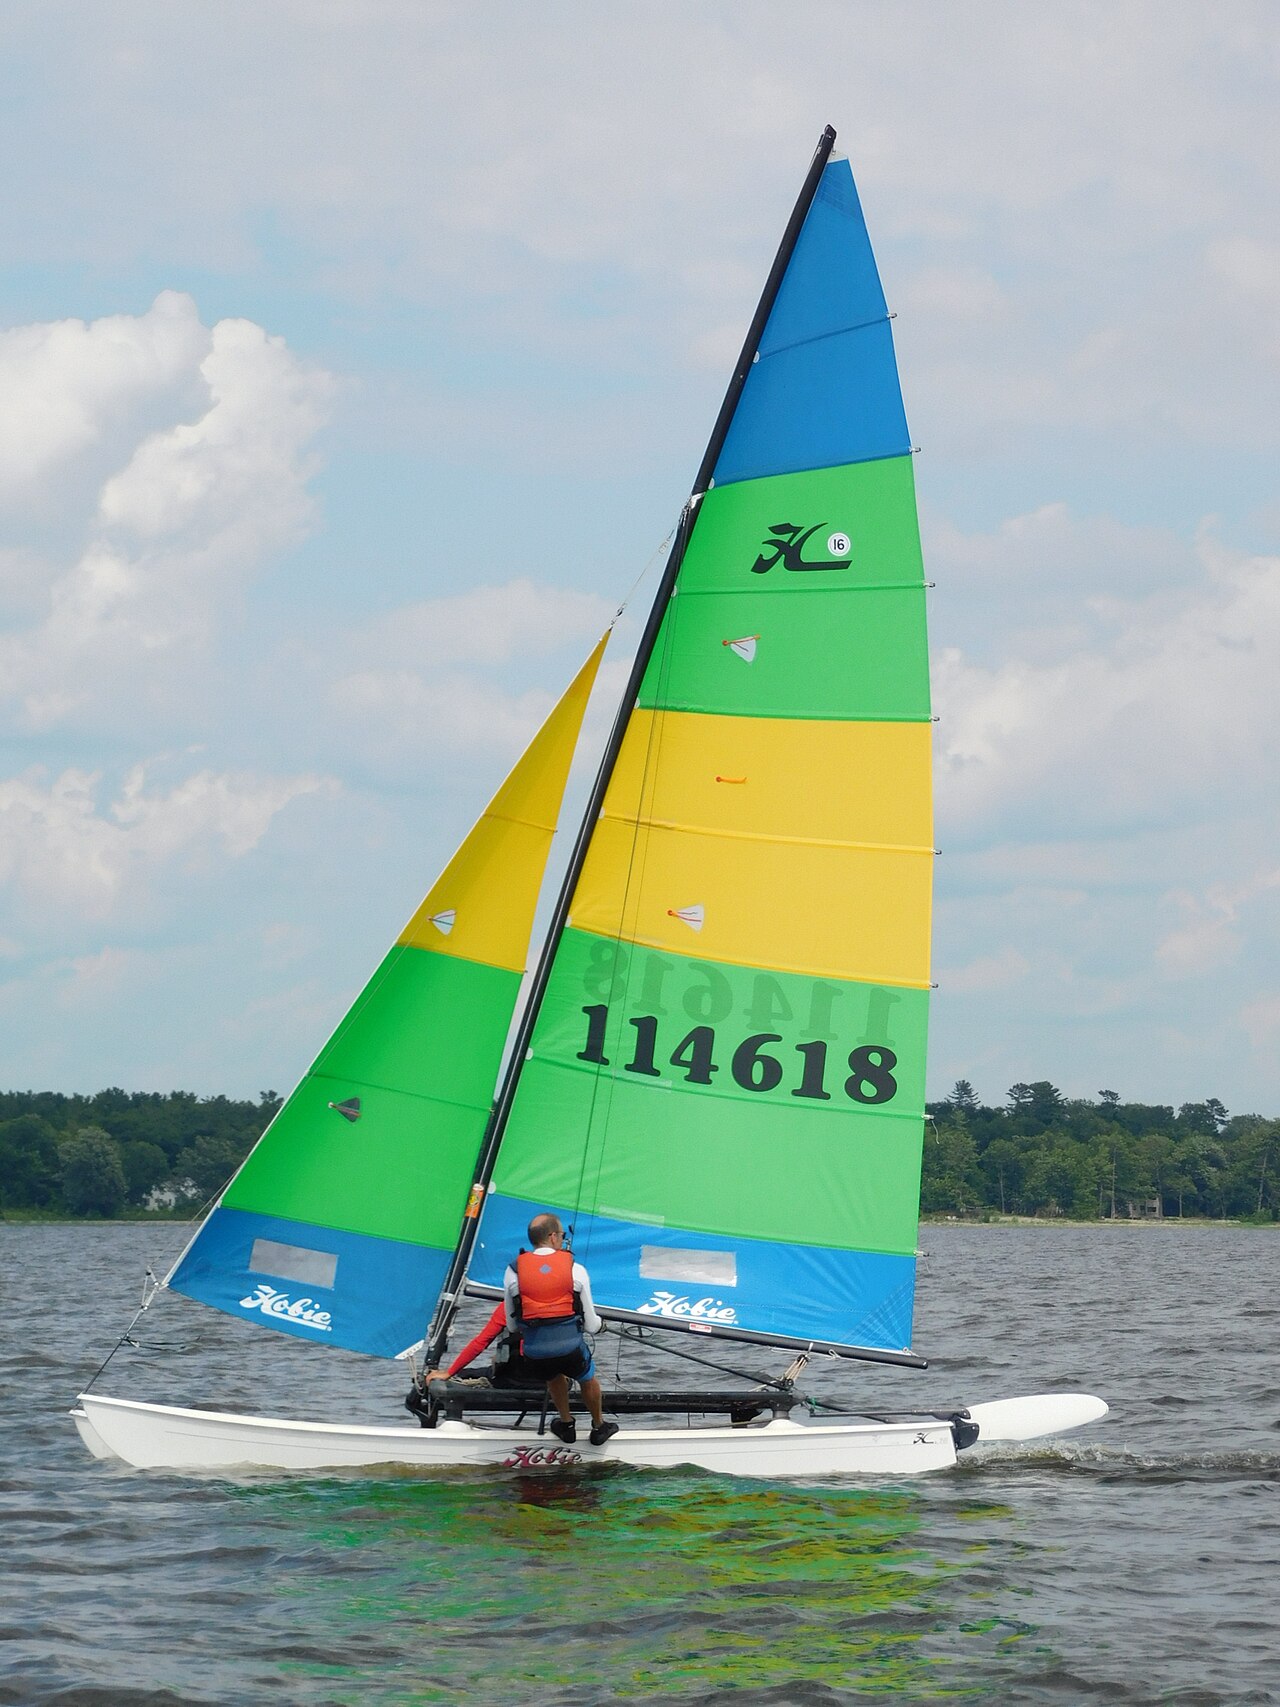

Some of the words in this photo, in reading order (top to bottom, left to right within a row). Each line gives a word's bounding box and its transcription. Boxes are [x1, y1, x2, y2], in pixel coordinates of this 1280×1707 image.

[833, 538, 845, 551] 16
[576, 1004, 898, 1105] 114618
[239, 1284, 332, 1331] Hobie
[636, 1291, 739, 1325] Hobie
[501, 1445, 583, 1469] Hobie
